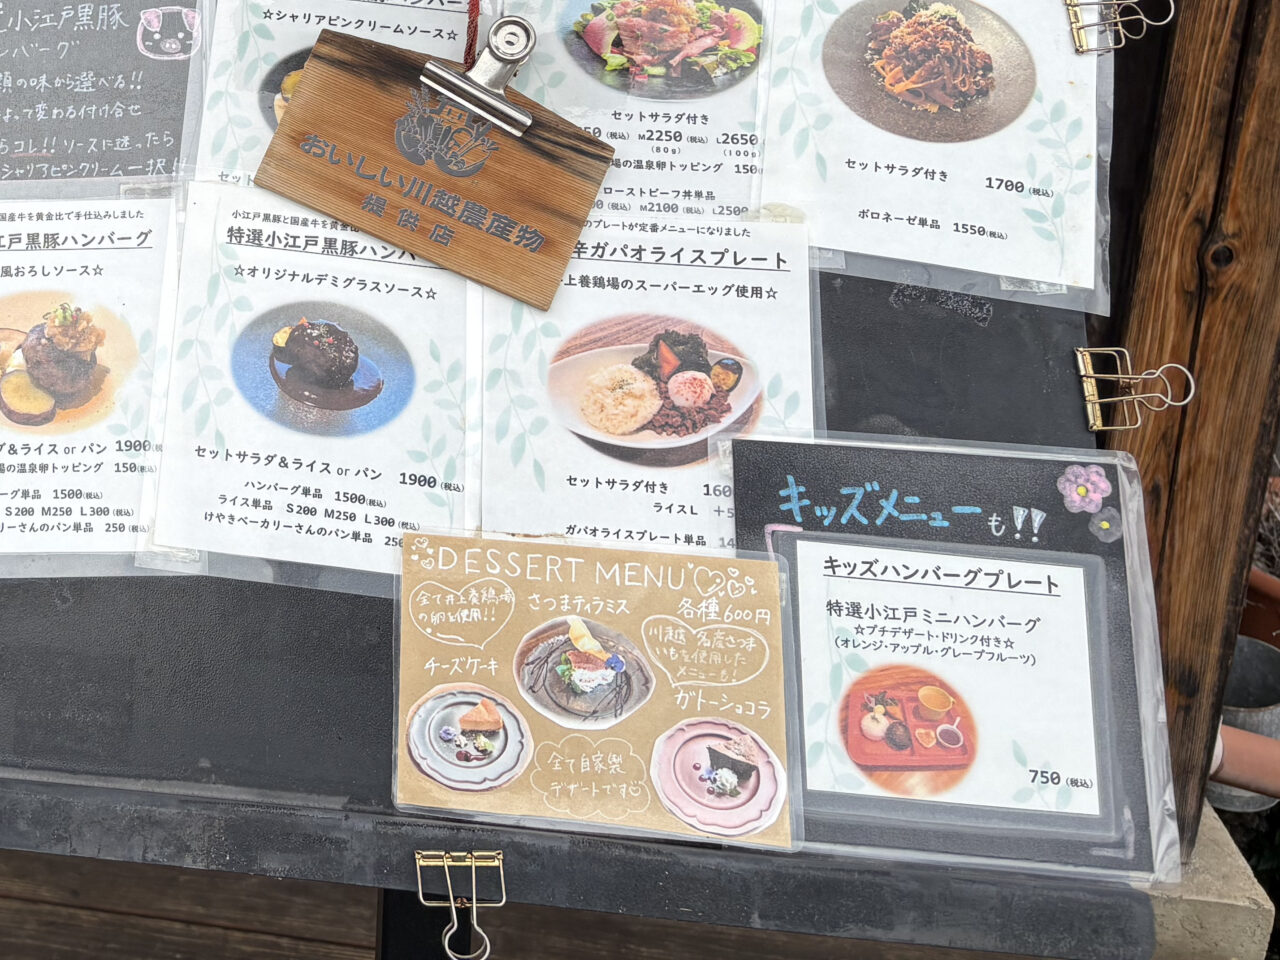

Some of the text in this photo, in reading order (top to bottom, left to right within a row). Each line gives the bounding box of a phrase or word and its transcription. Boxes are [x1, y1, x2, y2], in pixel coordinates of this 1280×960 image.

[611, 110, 710, 126] セットサラダ付き
[845, 158, 949, 182] セットサラダ付き
[299, 134, 546, 253] おいしい川越農産物
[858, 209, 941, 230] ボロネーゼ単品
[244, 480, 323, 500] ハンバーグ単品
[566, 475, 669, 495] セットサラダ付き
[218, 494, 273, 511] ライス単品
[204, 511, 373, 544] けやきベーカリーさんのパン単品
[565, 525, 707, 547] ガパオライスプレート単品
[438, 547, 686, 590] DESSERT MENU
[823, 555, 1060, 594] キッズハンバーグプレート
[527, 593, 631, 615] さつまティラミス
[825, 598, 1041, 634] 特選小江戸ミニハンバーグ
[424, 656, 499, 676] チーズケーキ
[675, 688, 771, 720] ガトーショコラ
[547, 750, 626, 775] 全て自家製
